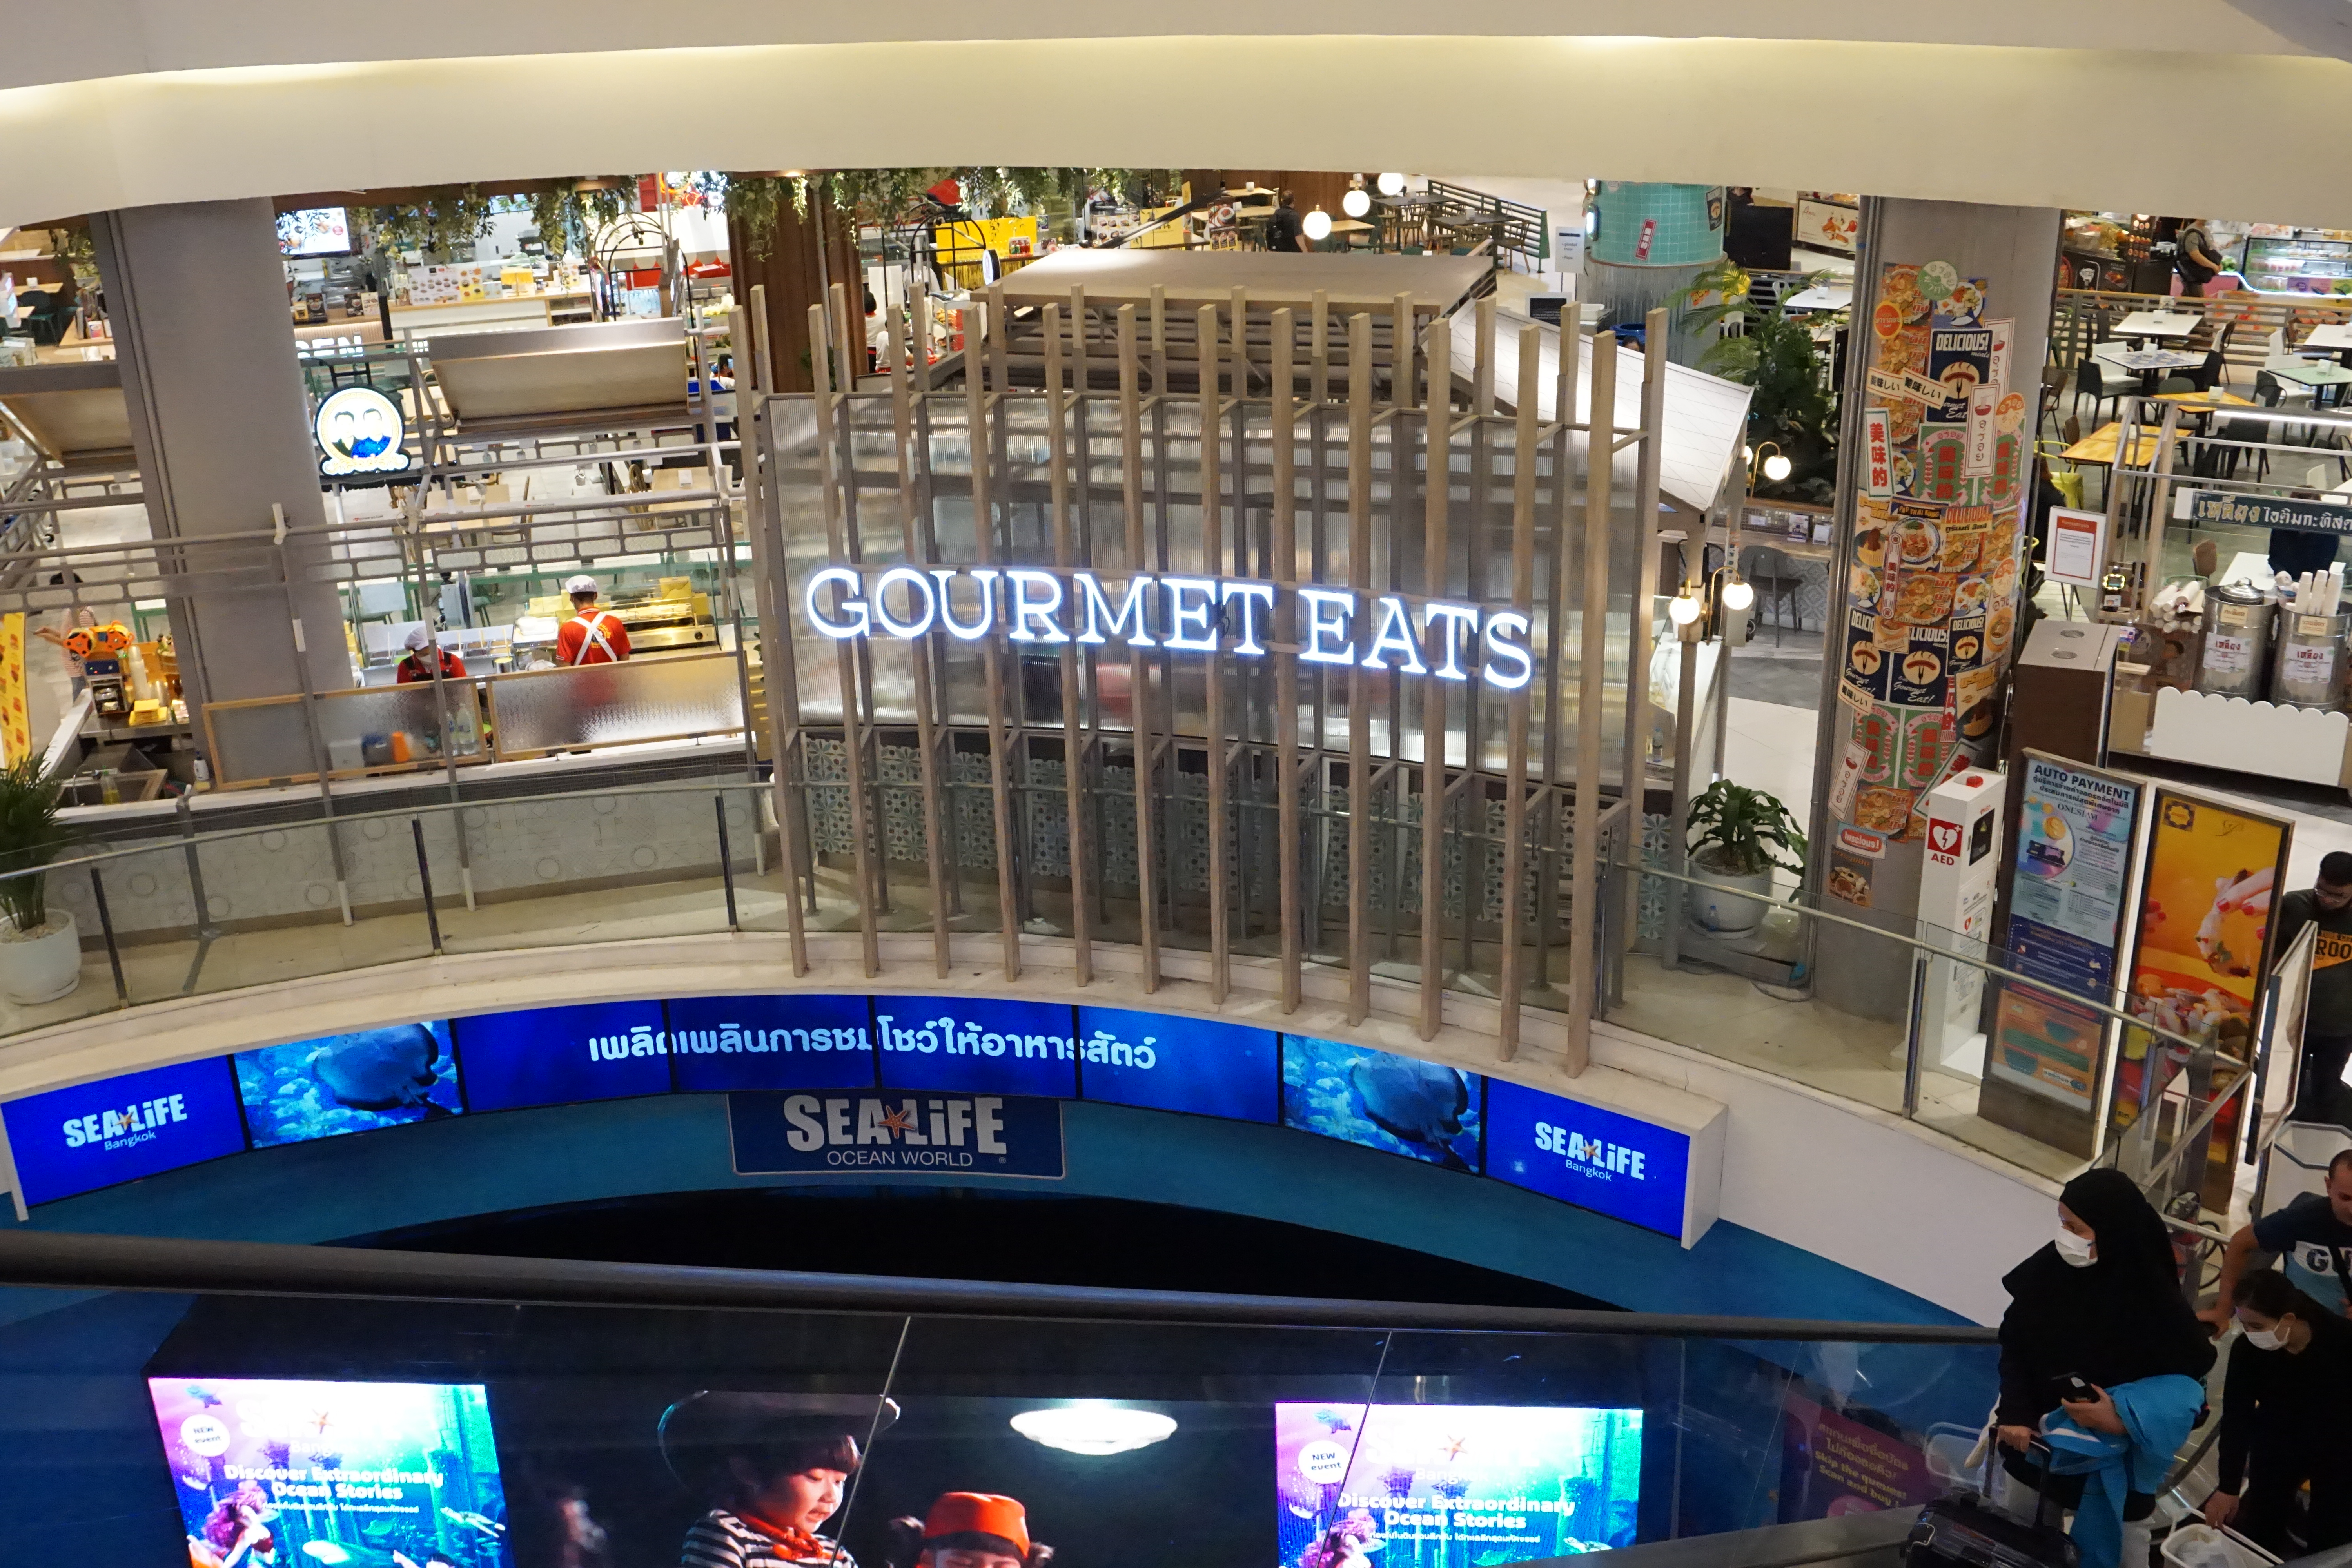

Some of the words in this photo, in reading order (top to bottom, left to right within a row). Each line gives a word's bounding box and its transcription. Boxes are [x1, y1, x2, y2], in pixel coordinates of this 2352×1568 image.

[1936, 333, 1989, 351] DELICIOUS!
[1870, 375, 1900, 391] 美味しい
[1905, 377, 1940, 399] 美味しい
[1946, 407, 1968, 419] Eat
[1870, 422, 1888, 487] 美味的
[2198, 495, 2260, 523] เหลียง
[806, 568, 1273, 655] GOURMET
[1298, 588, 1532, 689] EATS
[1952, 618, 1984, 631] DELICIOUS!
[1911, 627, 1948, 642] LICIOUS!
[1894, 682, 1927, 693] Gourmet
[1907, 692, 1936, 704] Eat!
[2034, 765, 2068, 782] AUTO
[2071, 775, 2131, 800] PAYMENT
[1845, 831, 1880, 849] luscious!
[1931, 853, 1955, 866] AED
[63, 1109, 126, 1148] SEA
[784, 1095, 891, 1152] SEA
[104, 1130, 156, 1151] Bangkok
[1535, 1122, 1586, 1162] SEA
[827, 1151, 895, 1166] OCEAN
[901, 1152, 973, 1167] WORLD
[1566, 1159, 1612, 1182] Bangkok
[194, 1435, 222, 1444] event
[1312, 1452, 1336, 1461] NEW
[1311, 1461, 1342, 1471] event
[224, 1465, 307, 1481] Discover
[311, 1466, 444, 1488] Extraordinary
[272, 1482, 331, 1498] Ocean
[334, 1483, 403, 1500] Stories
[1337, 1494, 1426, 1510] Discover
[1432, 1494, 1576, 1517] Extraordinary
[1384, 1511, 1447, 1527] Ocean
[1454, 1512, 1526, 1529] Stories
